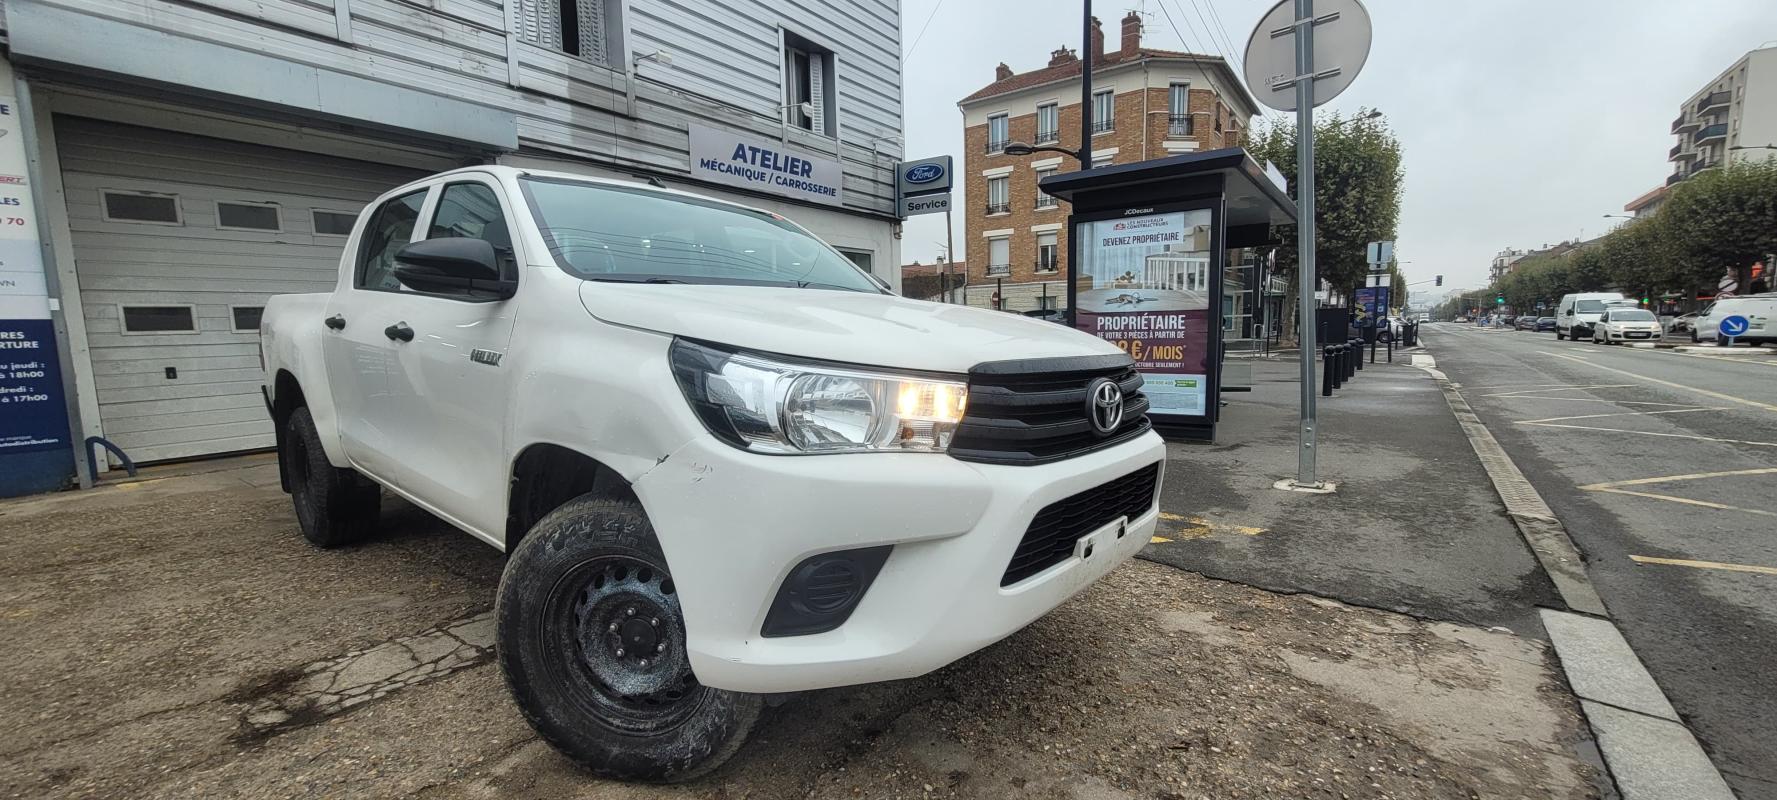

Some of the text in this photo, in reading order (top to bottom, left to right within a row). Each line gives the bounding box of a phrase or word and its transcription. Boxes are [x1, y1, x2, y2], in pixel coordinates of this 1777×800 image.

[731, 143, 813, 178] ATELIER
[700, 157, 837, 197] MÉCANIQUE / CARROSSERIE
[912, 168, 935, 181] Ford
[907, 199, 948, 212] Service
[7, 217, 25, 226] 70
[1127, 221, 1169, 230] CONSTRUCTEURS
[1102, 232, 1180, 247] DEVENEZ PROPRIÉTAIRE
[1097, 313, 1186, 331] PROPRIÉTAIRE
[1105, 331, 1122, 339] VOTRE
[1123, 331, 1128, 339] 3
[1128, 330, 1148, 339] PIÈCES
[1149, 330, 1154, 339] À
[1154, 331, 1176, 339] PARTIR
[10, 361, 38, 371] jeudi
[9, 371, 45, 379] 18h00
[13, 394, 49, 402] 17h00
